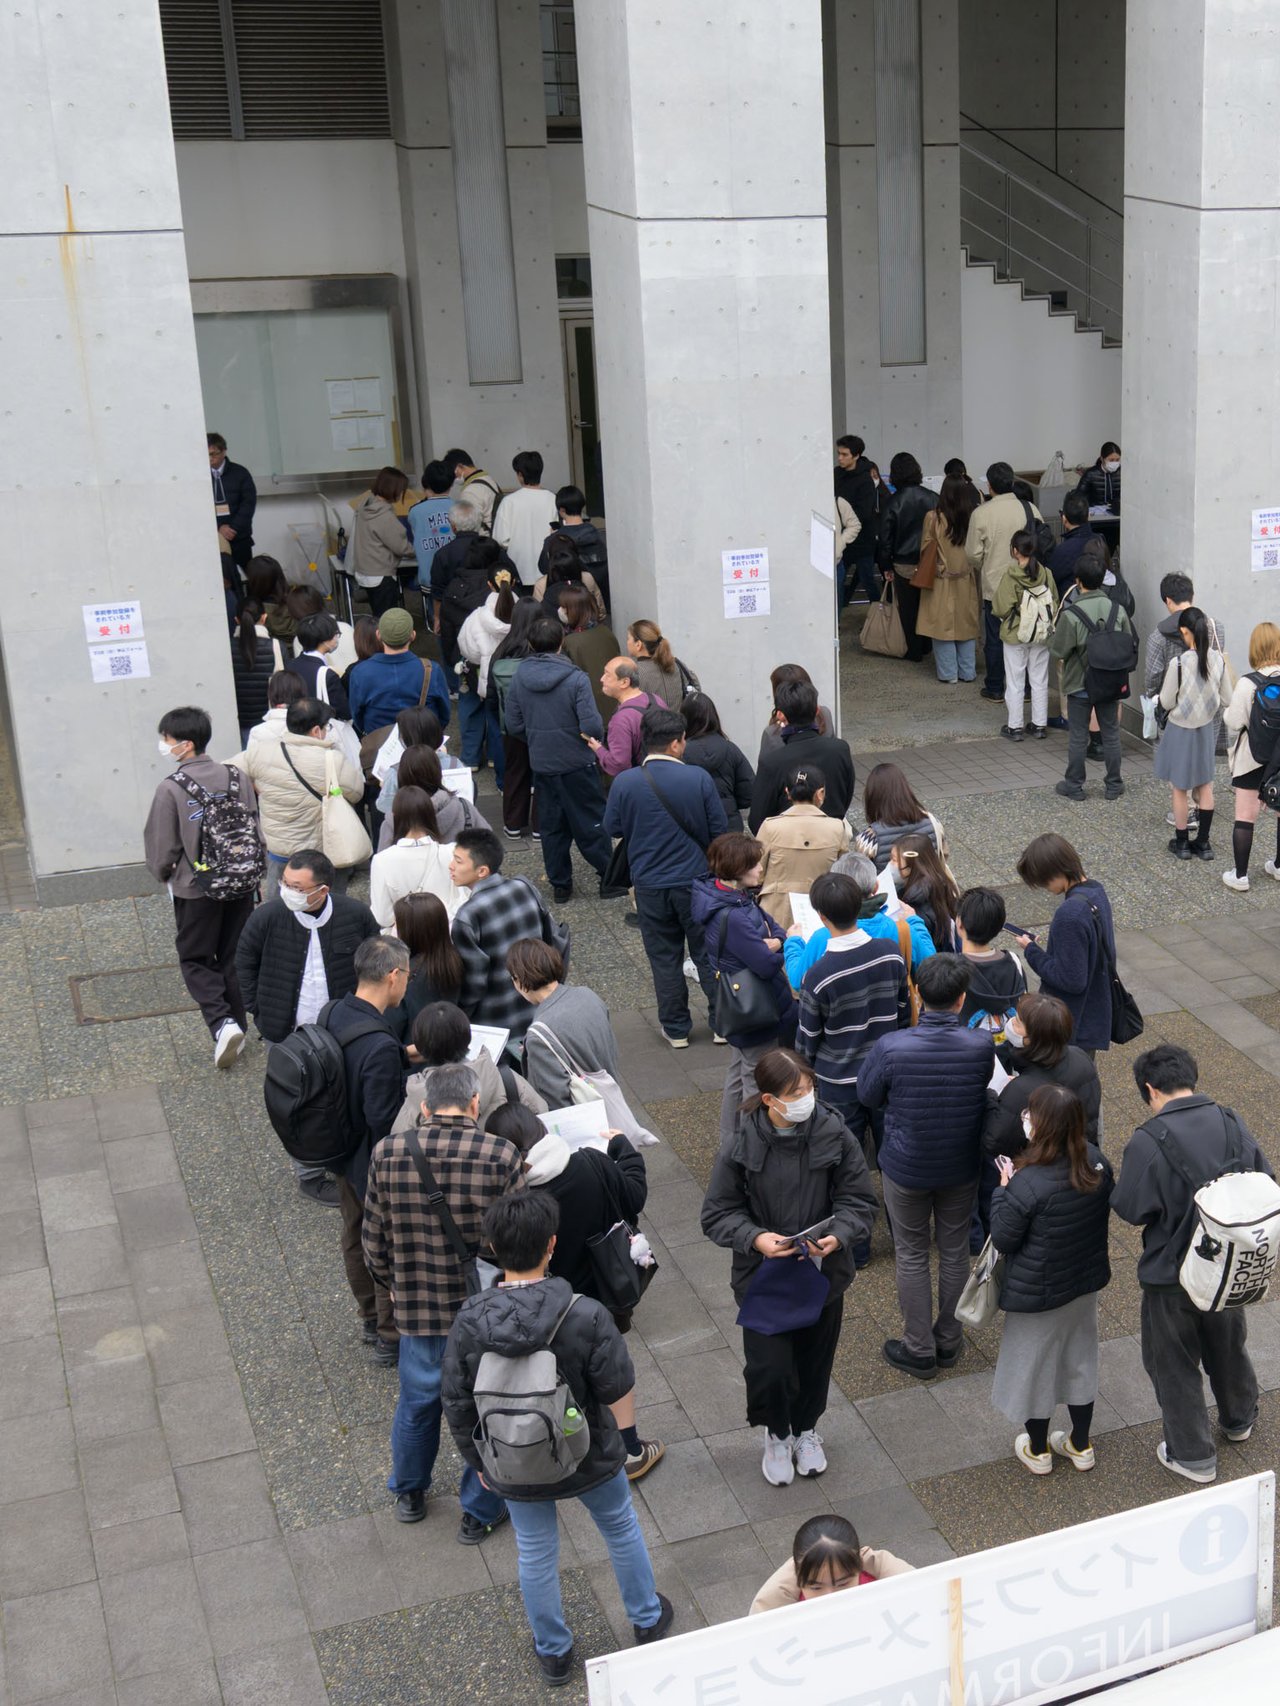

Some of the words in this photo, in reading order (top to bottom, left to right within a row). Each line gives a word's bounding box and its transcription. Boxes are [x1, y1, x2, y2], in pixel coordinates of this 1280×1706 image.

[428, 512, 450, 528] MAR
[422, 536, 452, 551] GONZA
[1231, 1250, 1255, 1291] FACE
[1246, 1228, 1269, 1289] NORTH
